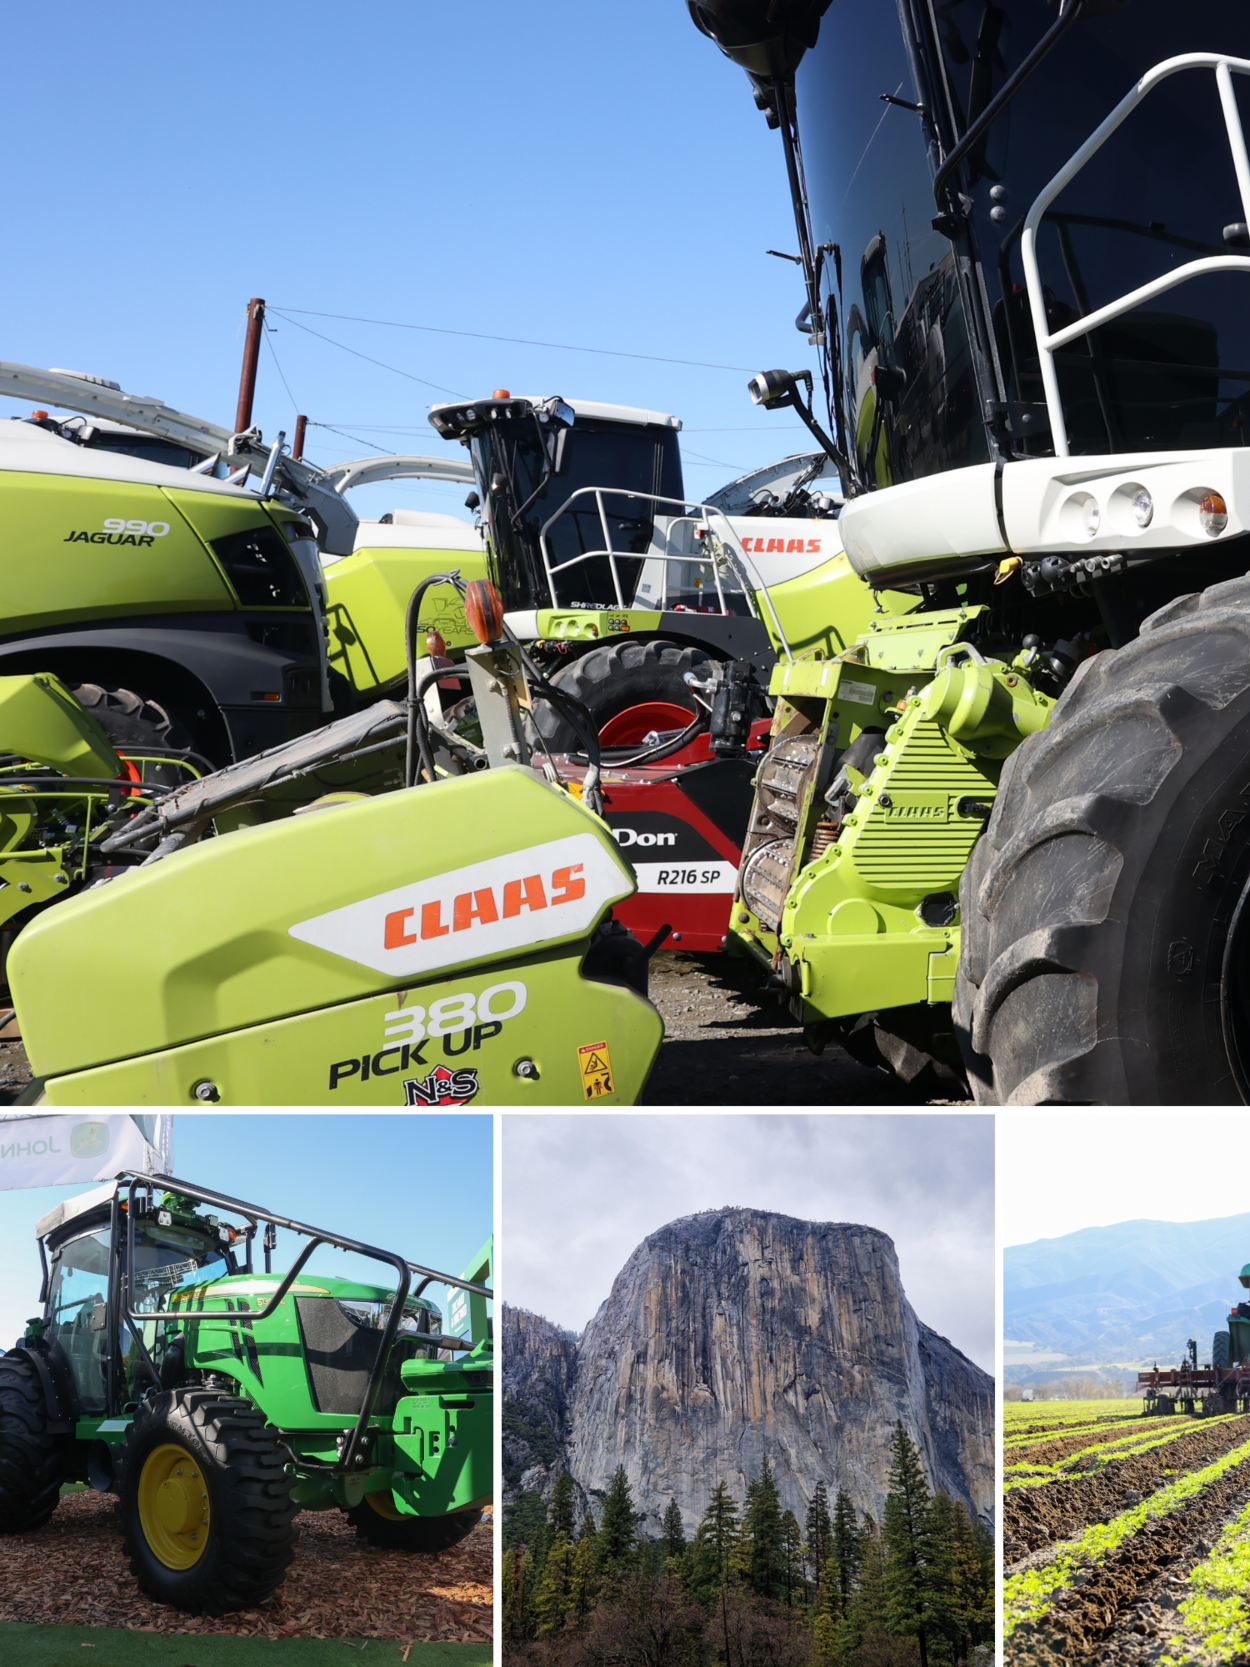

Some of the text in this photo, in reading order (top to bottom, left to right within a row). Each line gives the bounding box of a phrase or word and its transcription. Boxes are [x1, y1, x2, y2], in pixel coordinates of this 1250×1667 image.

[102, 518, 170, 536] 990
[63, 531, 155, 547] JAGUAR
[741, 537, 822, 553] CLAAS
[570, 601, 627, 611] SHREDLAG
[888, 806, 945, 818] CLAAS
[657, 869, 721, 886] R216 SP
[384, 863, 586, 950] CLAAS
[382, 981, 528, 1051] 380
[329, 1020, 502, 1090] PICK UP
[403, 1068, 480, 1106] N&S
